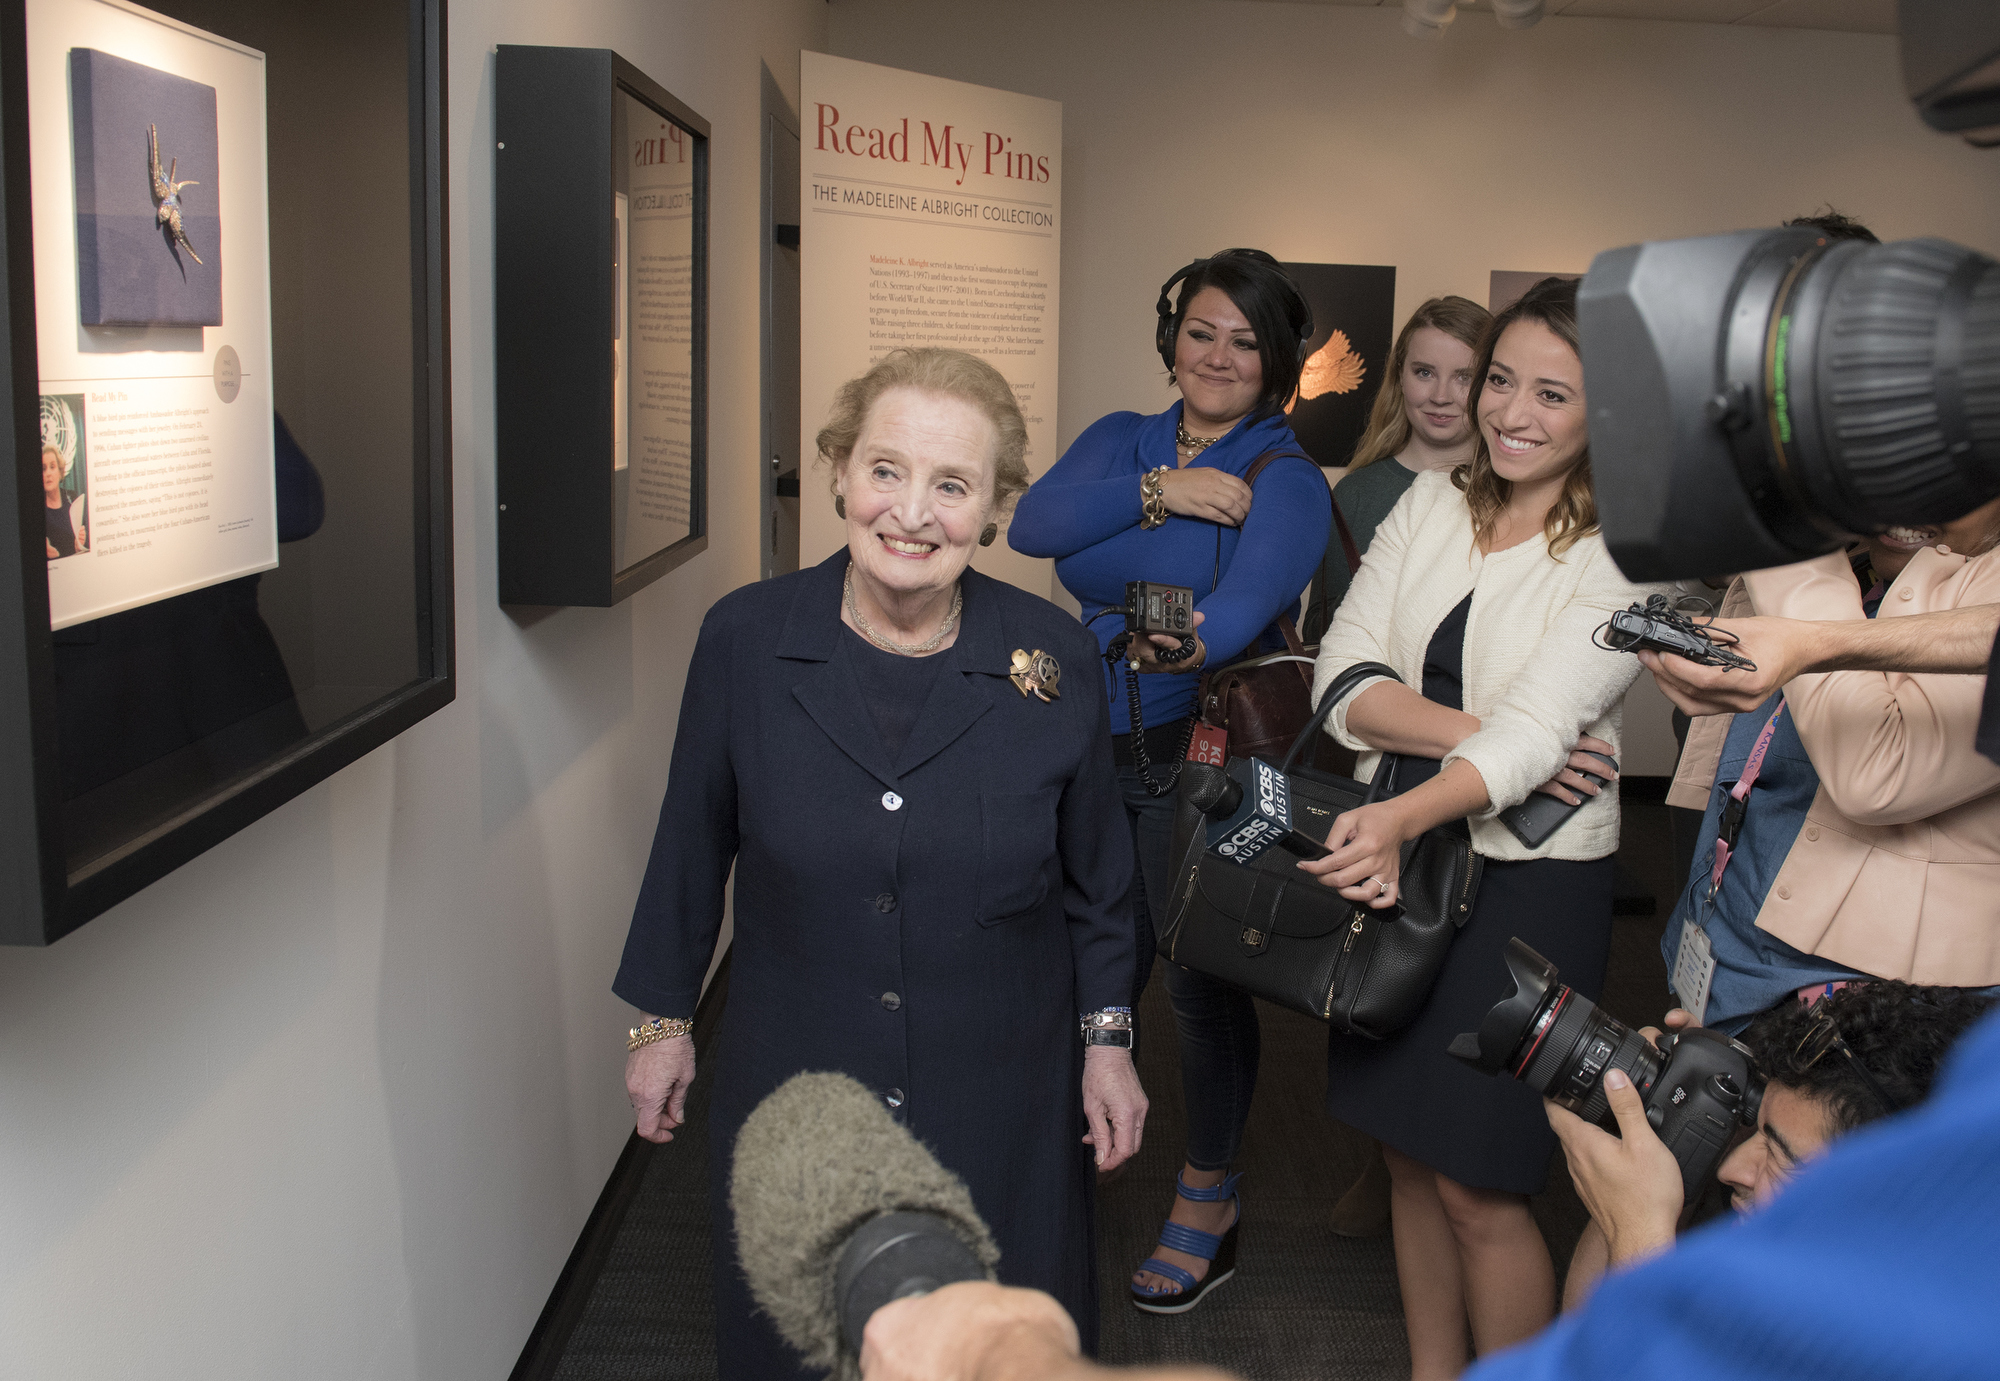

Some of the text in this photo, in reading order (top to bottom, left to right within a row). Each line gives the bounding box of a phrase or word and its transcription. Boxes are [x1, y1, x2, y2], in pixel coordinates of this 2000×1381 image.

[814, 102, 1050, 186] Read My Pins
[812, 184, 1052, 227] THE MADELEINE ALBRIGHT COLLECTION
[92, 391, 128, 404] Read My Pin
[1748, 732, 1773, 769] KANSAS
[1259, 764, 1273, 801] CBS
[1275, 772, 1287, 825] AUSTIN
[1231, 818, 1269, 846] CBS
[1234, 826, 1283, 864] AUSTIN
[1675, 1087, 1686, 1100] EOS
